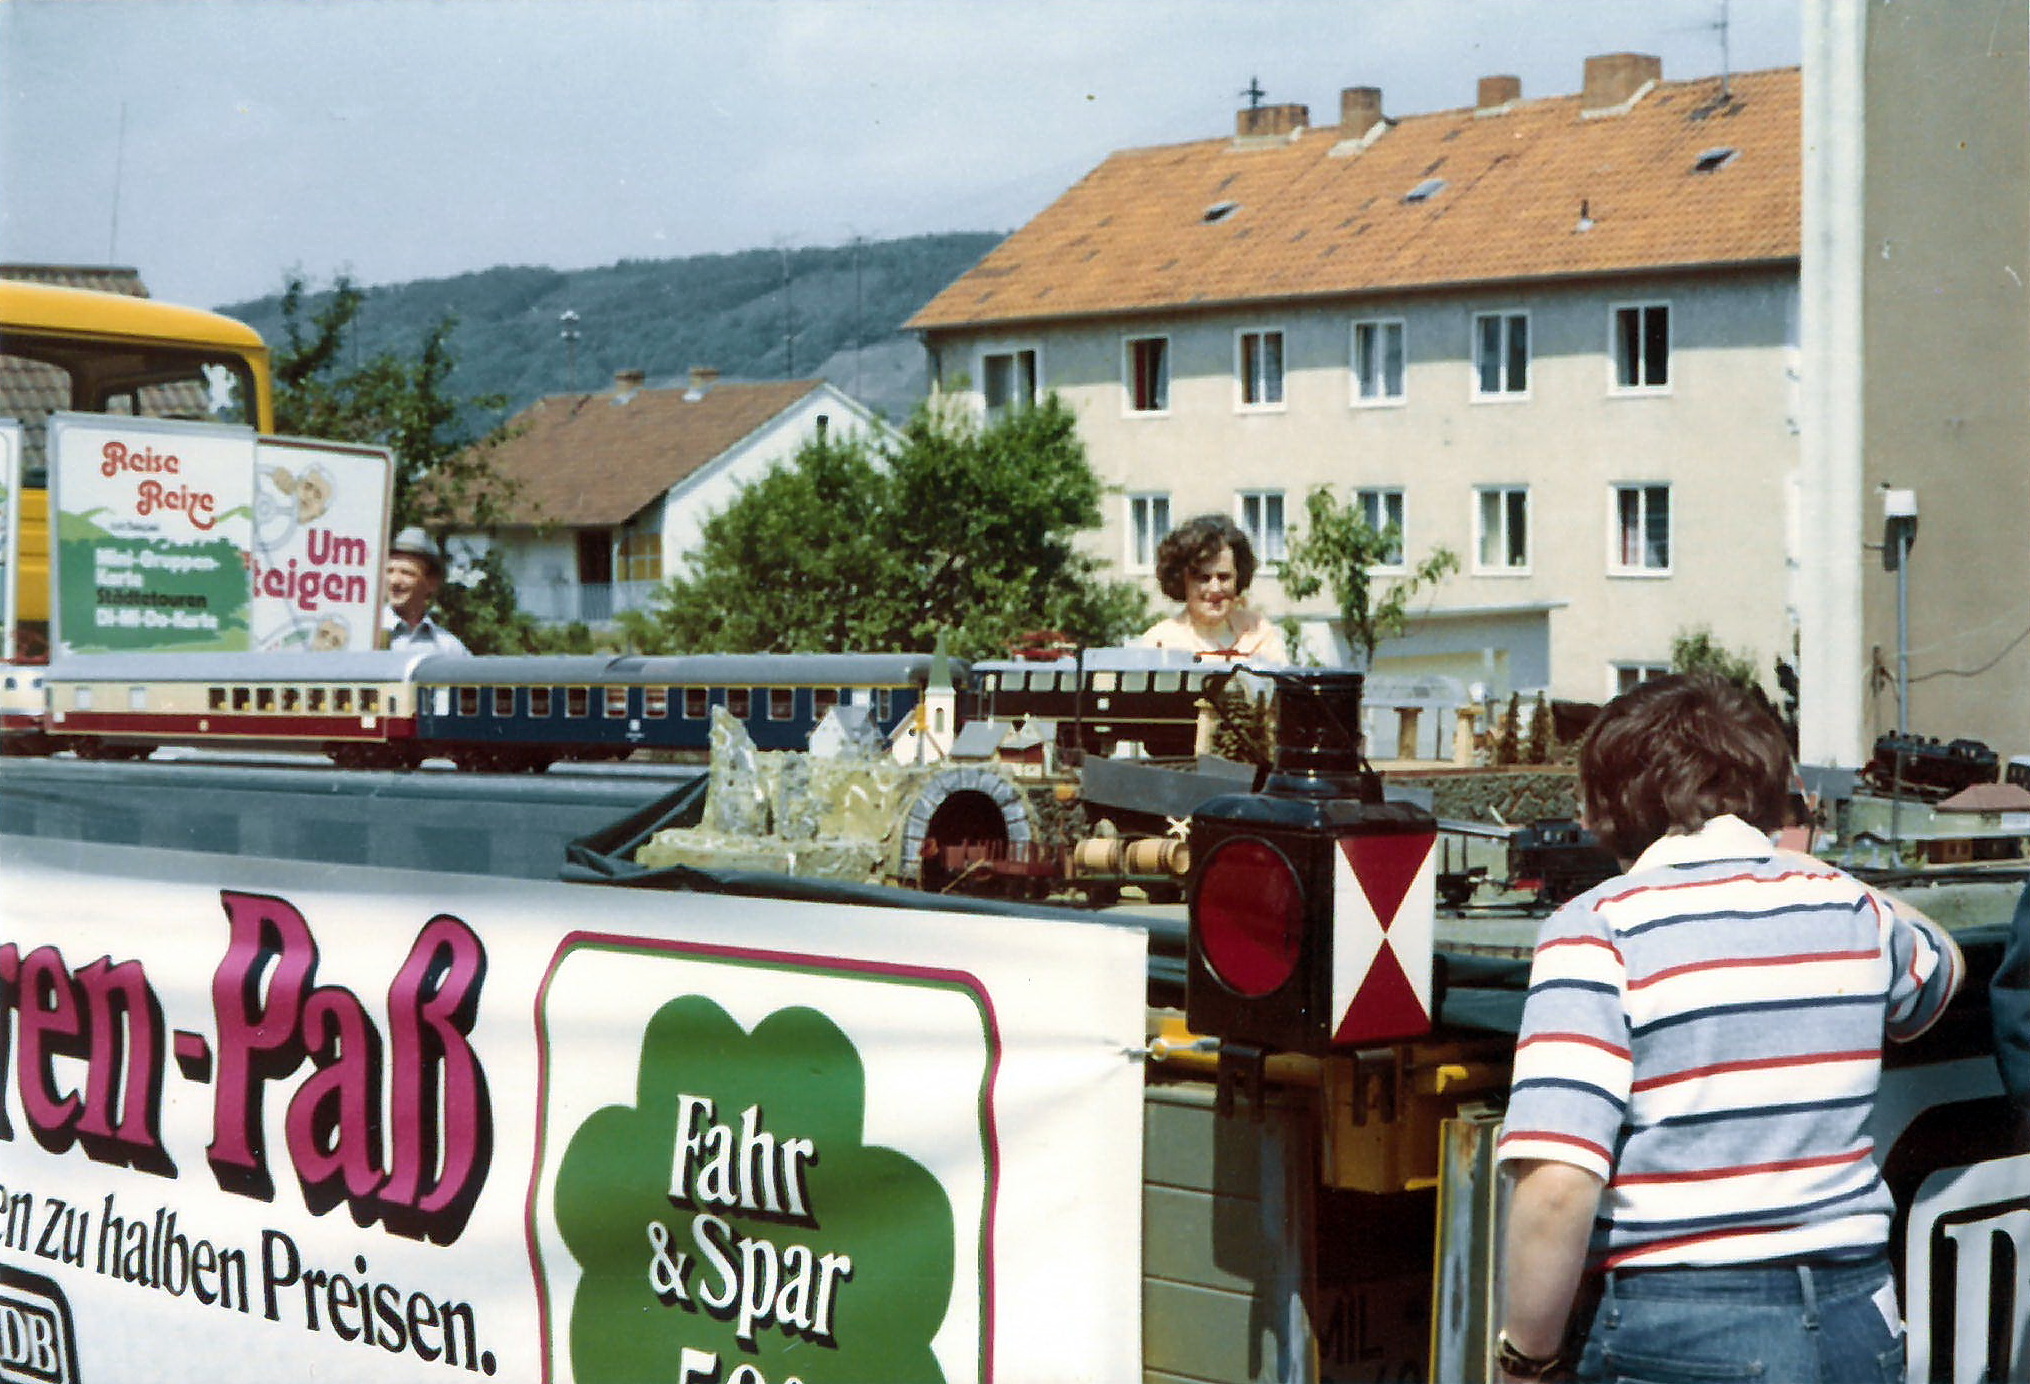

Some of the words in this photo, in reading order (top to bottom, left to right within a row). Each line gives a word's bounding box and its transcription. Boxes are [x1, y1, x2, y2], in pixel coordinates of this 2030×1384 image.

[101, 441, 180, 477] Reise
[136, 480, 217, 530] Reize
[308, 528, 367, 566] Um
[668, 1093, 819, 1229] Fahr
[0, 1184, 33, 1251] n
[34, 1198, 89, 1268] zu
[96, 1193, 249, 1312] halben
[262, 1229, 496, 1376] Preisen.
[648, 1220, 697, 1312] &
[692, 1213, 853, 1353] Spar
[0, 1304, 58, 1372] DB
